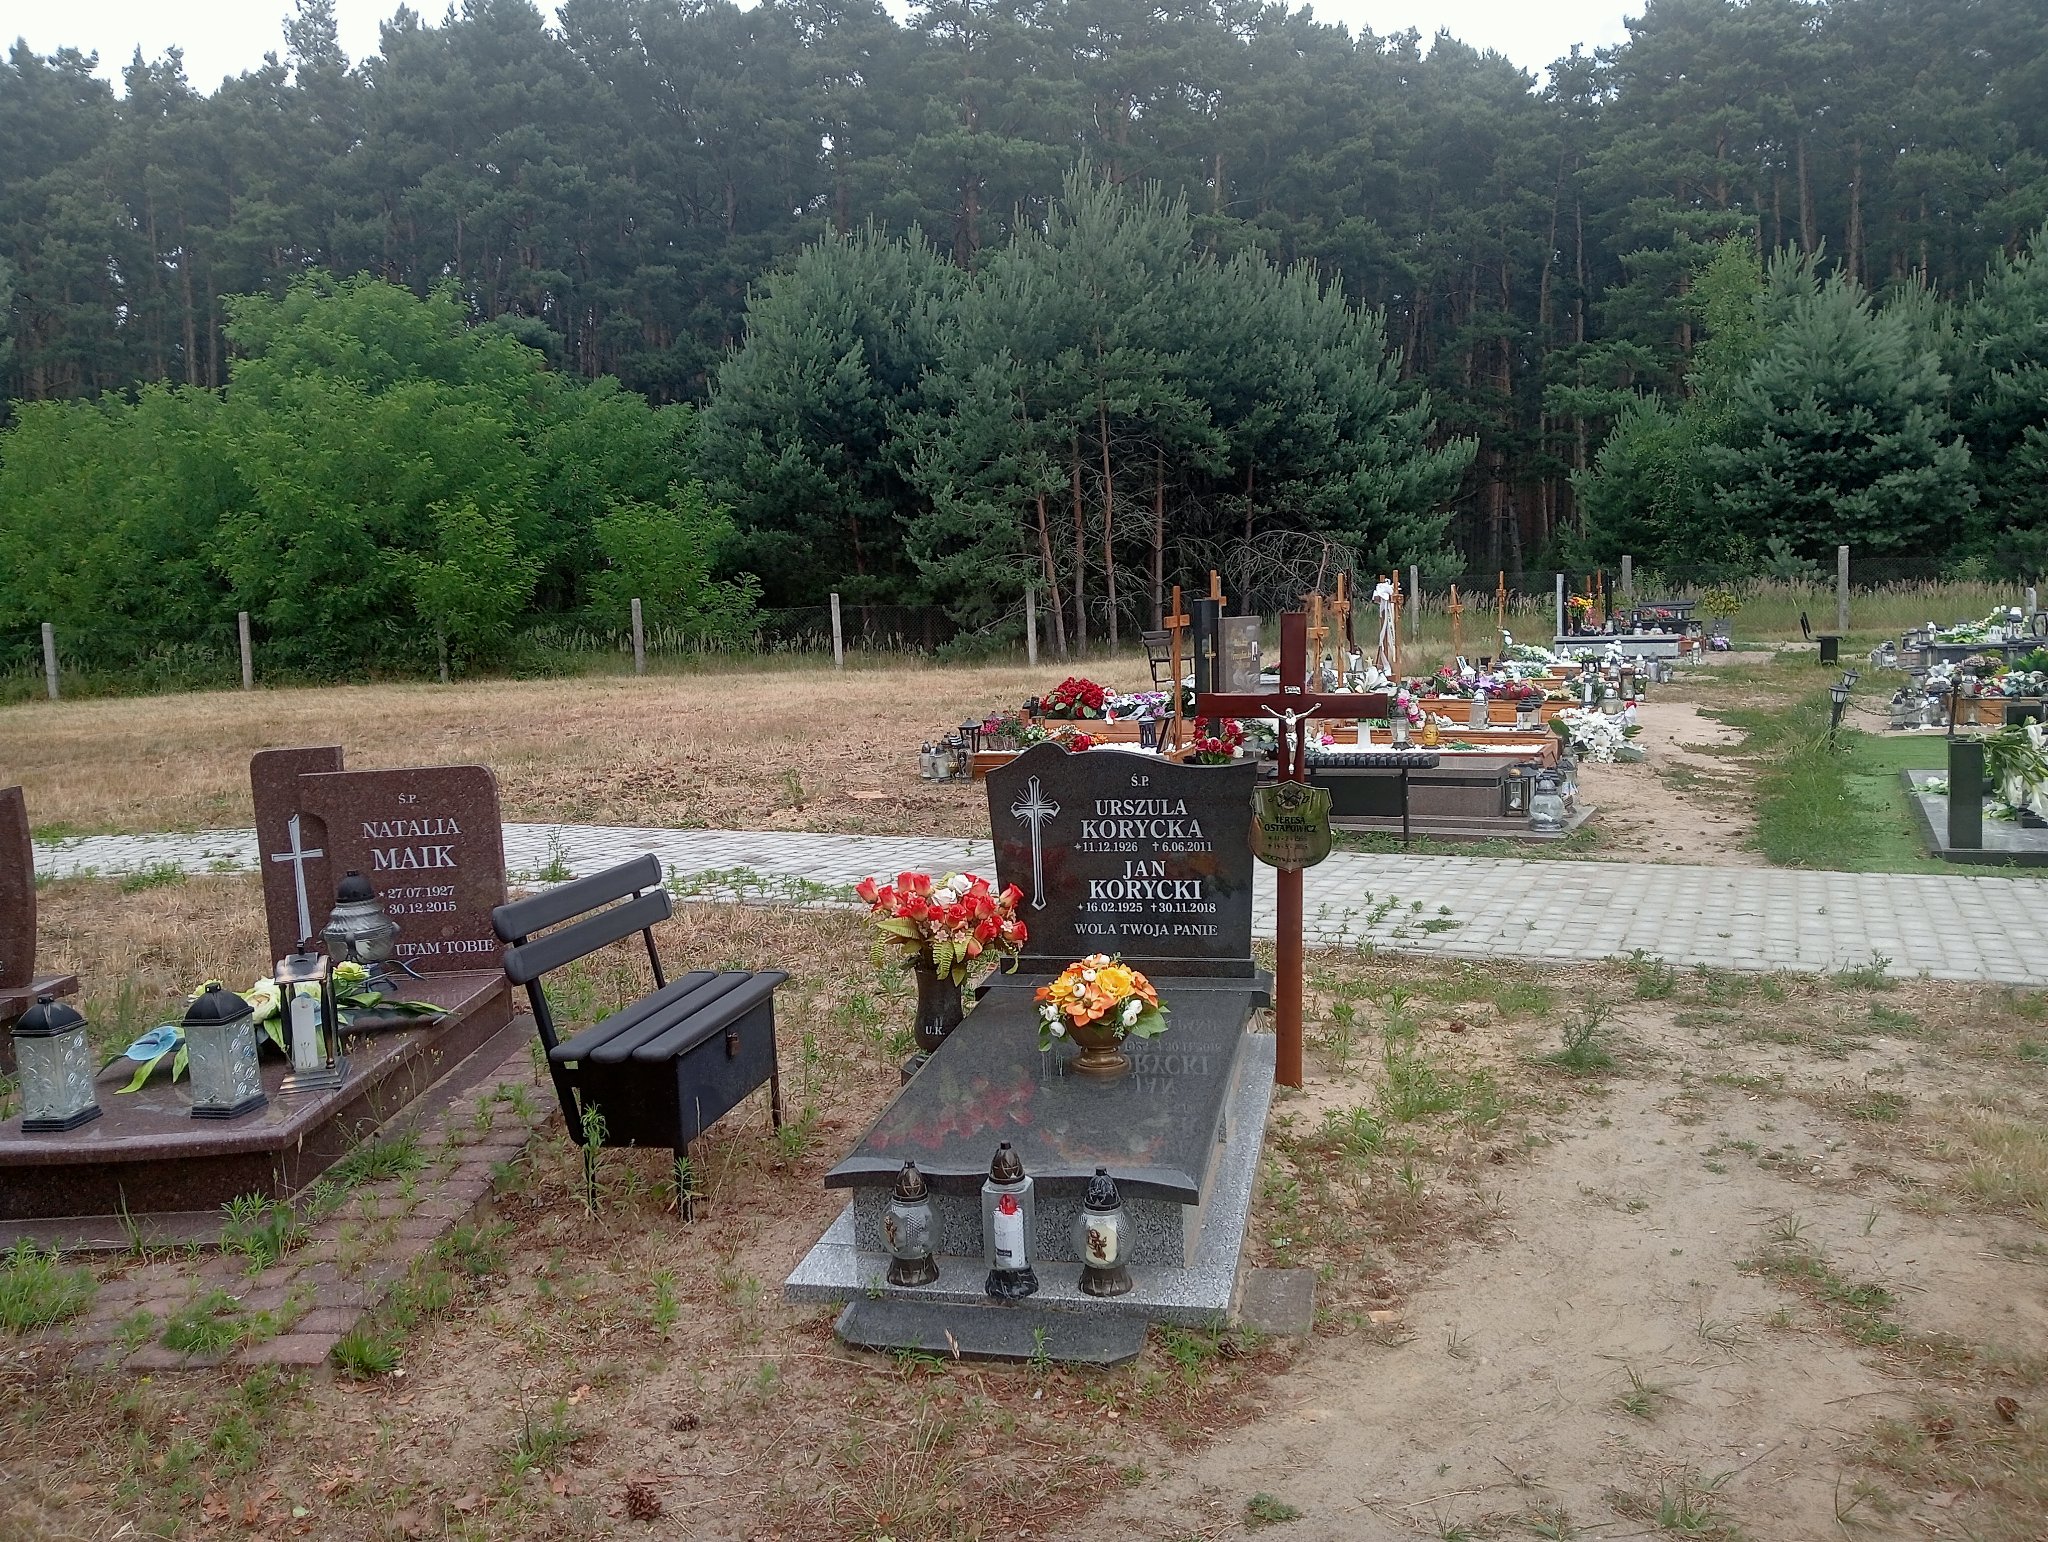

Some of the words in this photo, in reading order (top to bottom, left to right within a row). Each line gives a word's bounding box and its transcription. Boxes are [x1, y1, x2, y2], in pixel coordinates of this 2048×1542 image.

[1094, 799, 1188, 816] URSZULA
[361, 817, 462, 840] NATALIA
[1080, 818, 1204, 839] KORYCKA
[1275, 815, 1306, 825] TERESA
[370, 845, 457, 871] MAIK
[1122, 859, 1167, 880] JAN
[387, 885, 455, 899] 27.07.1927
[1088, 879, 1203, 900] KORYCKI
[388, 901, 457, 915] 30.12.2015
[1074, 922, 1117, 935] WOLA
[1119, 923, 1170, 937] TWOJA
[1173, 923, 1218, 936] PANIE
[394, 942, 441, 956] UFAM
[443, 939, 495, 954] TOBIE
[925, 1026, 946, 1036] U.K.
